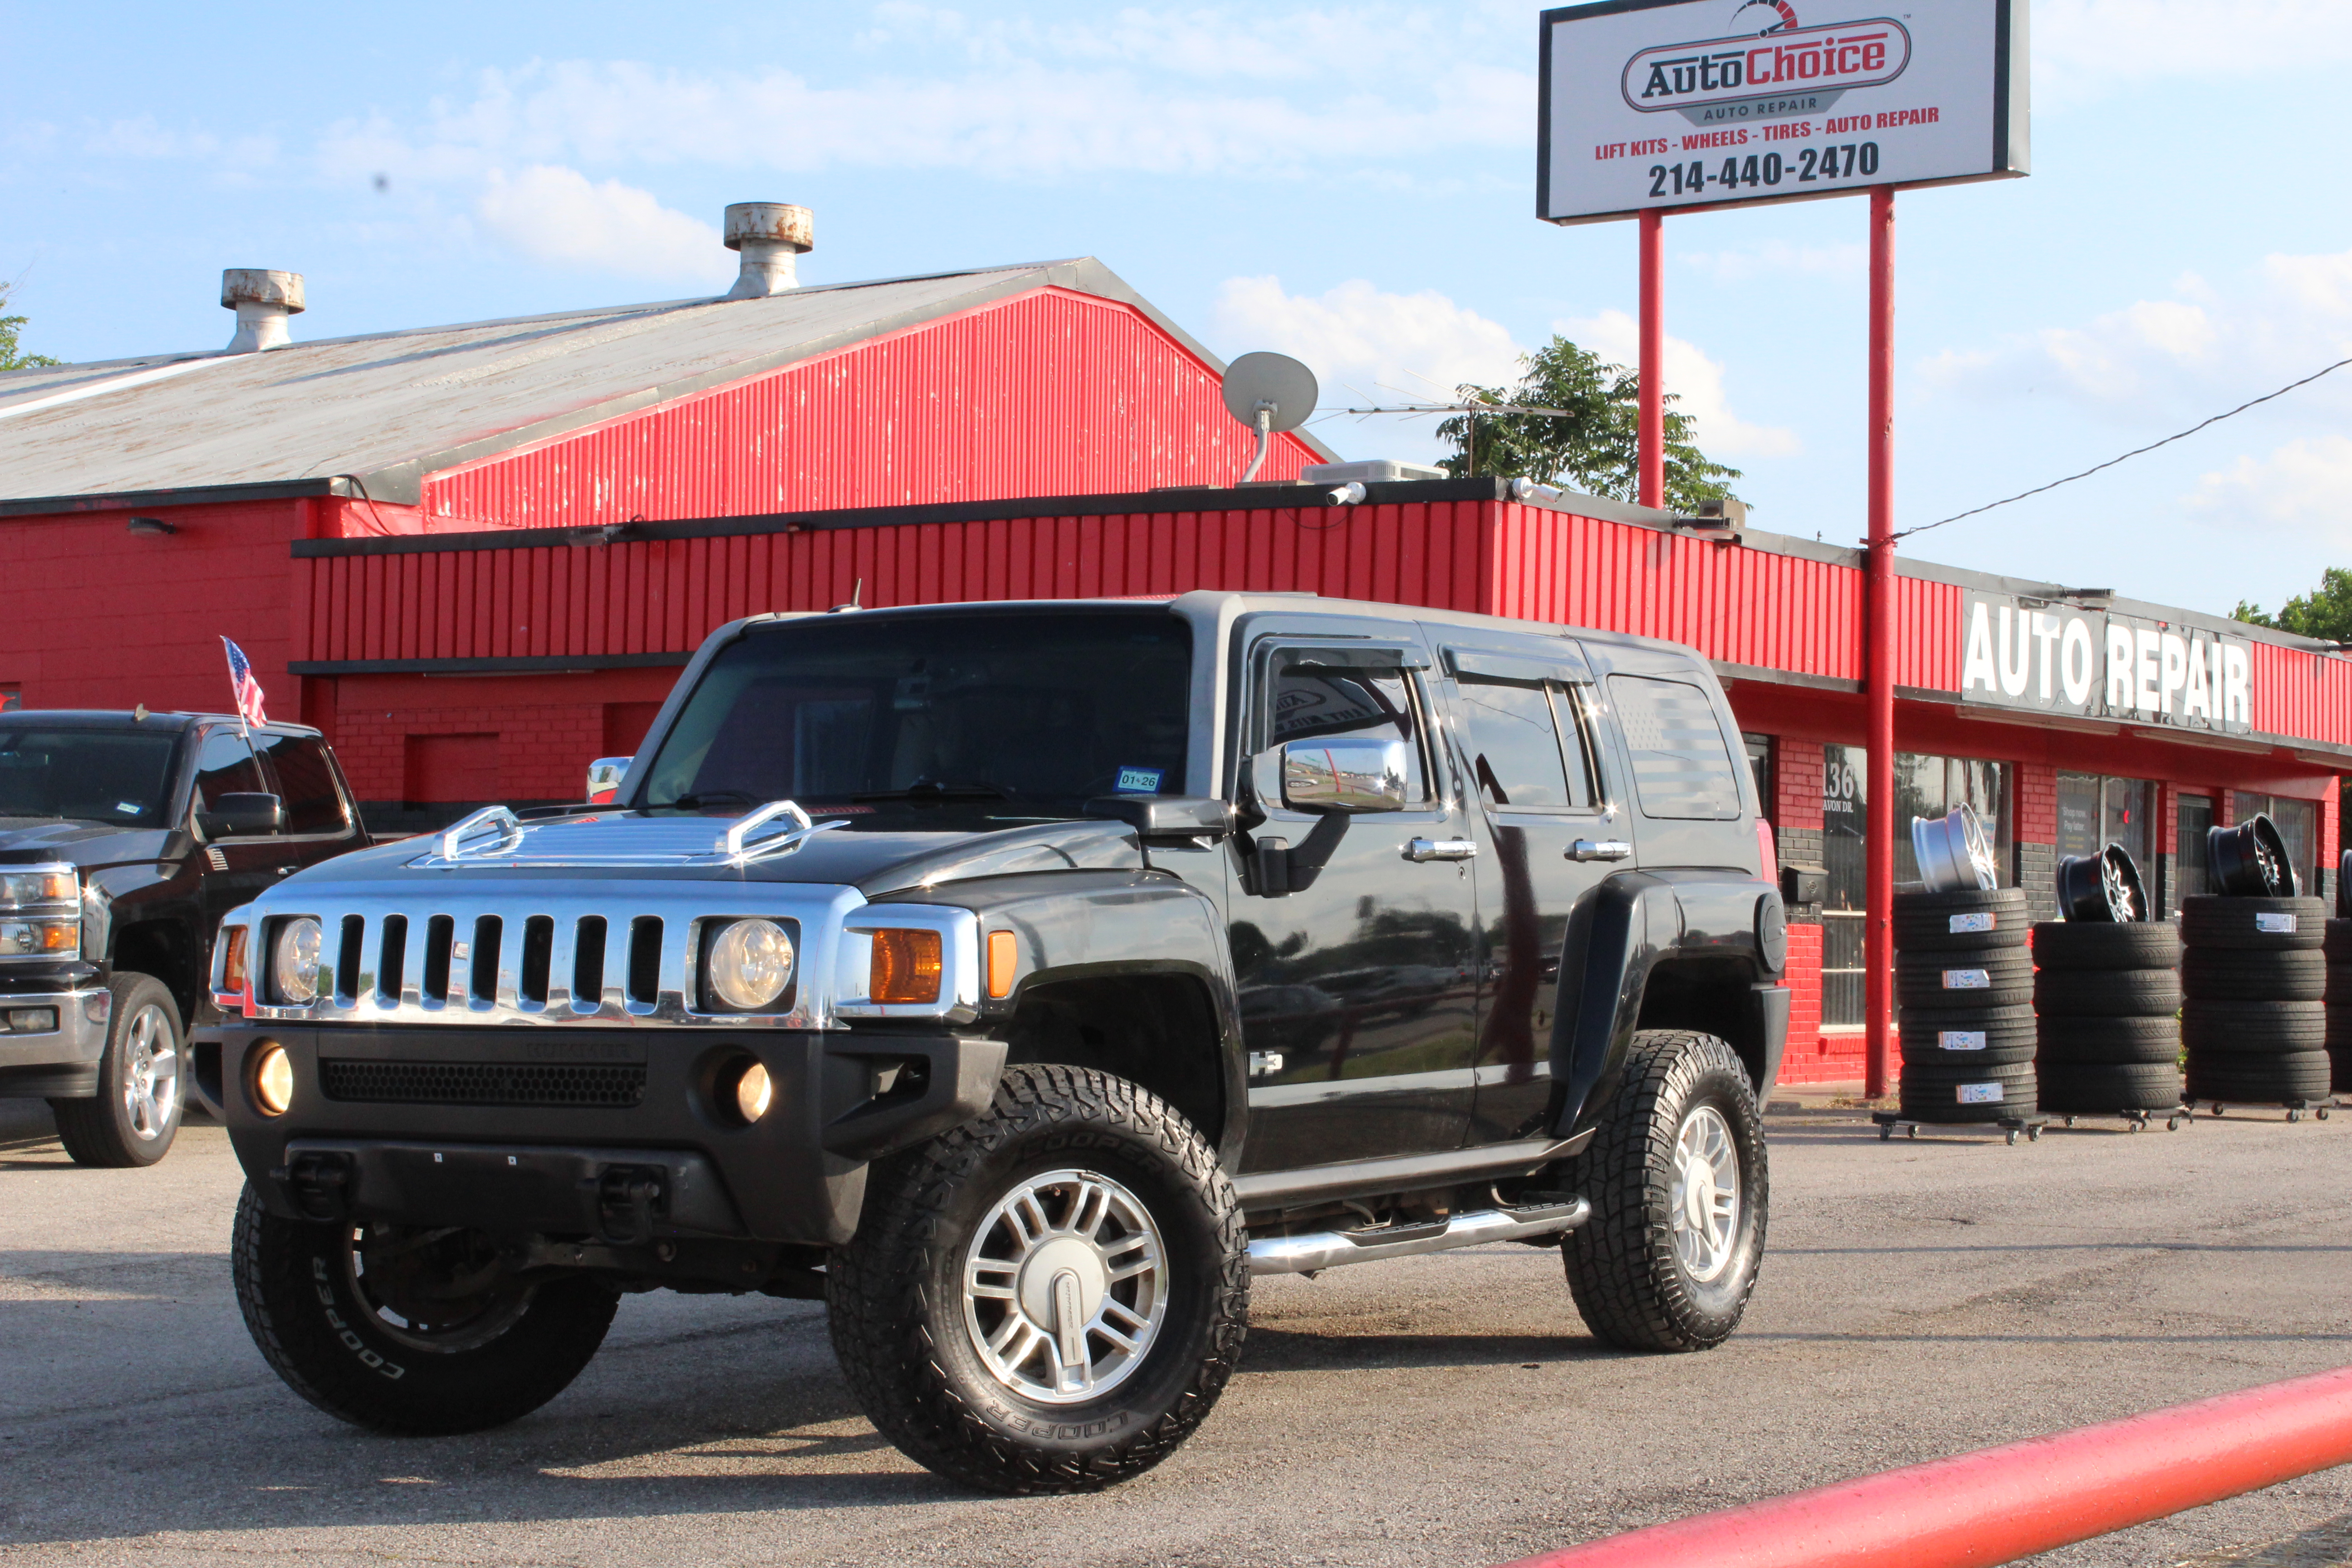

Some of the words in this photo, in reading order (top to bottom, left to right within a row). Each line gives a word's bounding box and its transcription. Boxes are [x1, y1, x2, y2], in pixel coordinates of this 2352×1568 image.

[1642, 33, 1888, 98] AutoChoice
[1595, 143, 1627, 160] LIFT
[1631, 138, 1668, 157] KITS
[1682, 128, 1748, 151] WHEELS
[1762, 122, 1811, 141] TIRES
[1825, 114, 1872, 134] AUTO
[1877, 107, 1939, 128] REPAIR
[1704, 105, 1748, 121] AUTO
[1758, 98, 1817, 114] REPAIR
[1649, 141, 1879, 198] 214-440-2470
[1962, 602, 2093, 706] AUTO
[2107, 623, 2249, 724] REPAIR
[1249, 1051, 1284, 1076] H3
[312, 1256, 405, 1380] COOPER
[1064, 1281, 1074, 1330] HUMMER
[986, 1398, 1129, 1440] COOPER
